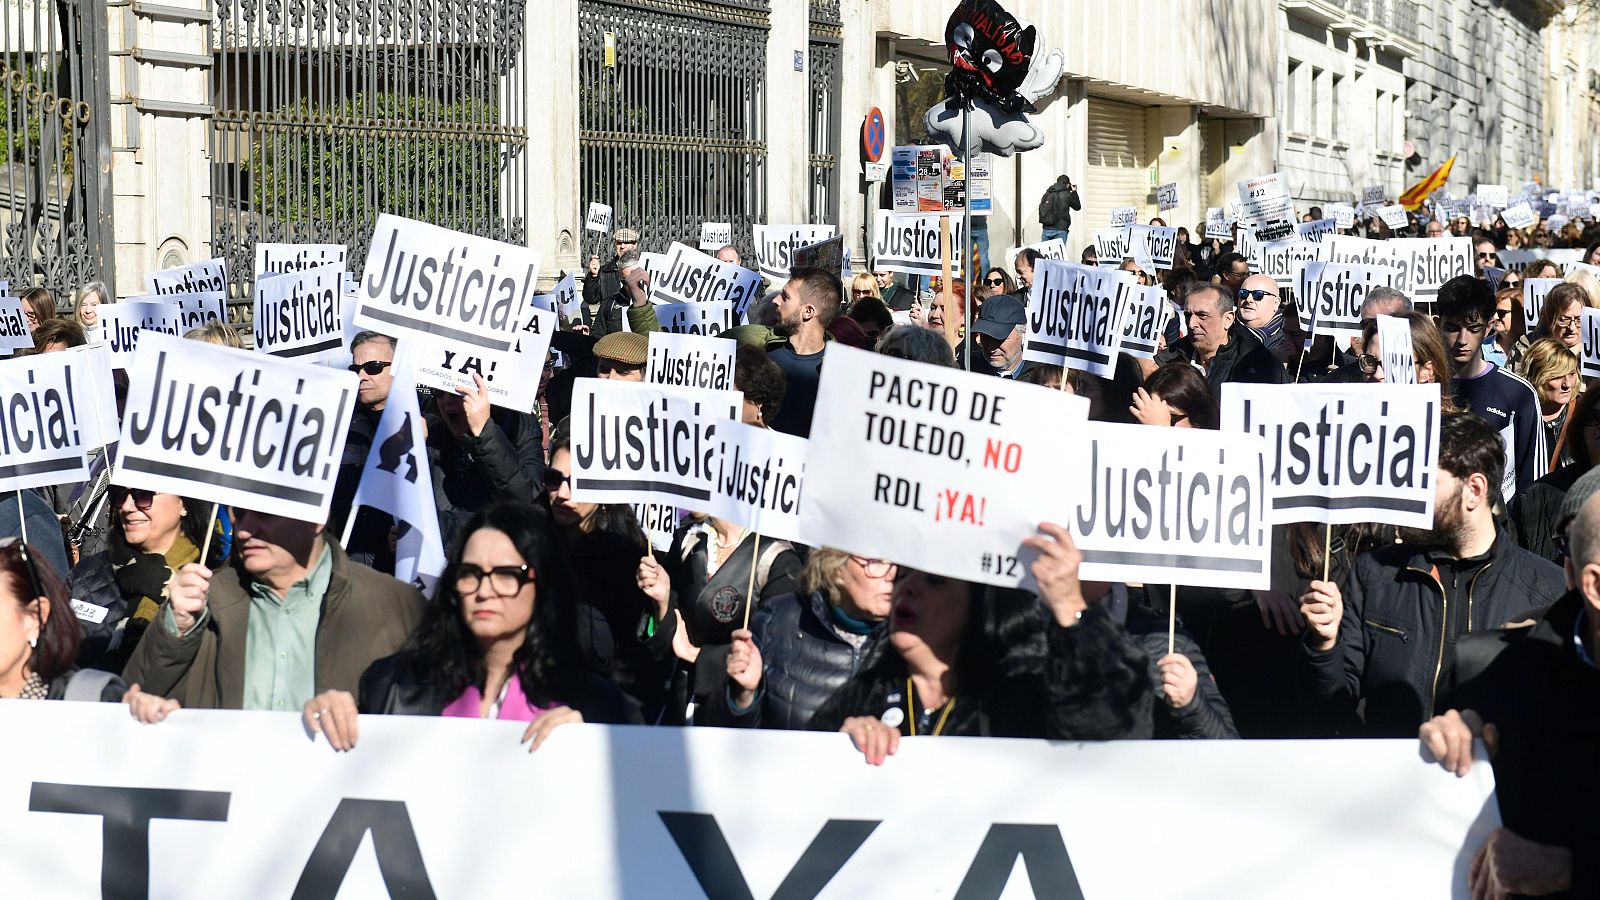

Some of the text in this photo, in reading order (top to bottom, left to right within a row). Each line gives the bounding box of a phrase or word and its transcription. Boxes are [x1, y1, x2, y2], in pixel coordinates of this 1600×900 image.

[1250, 188, 1266, 198] #J2
[877, 216, 960, 260] Justici!
[367, 228, 535, 333] Justicia!
[1031, 270, 1124, 346] Justicia!
[256, 272, 342, 349] Justicia!
[441, 350, 497, 382] YA!
[457, 377, 509, 397] PROCDORES
[130, 350, 349, 482] Justicia!
[869, 371, 1006, 426] PACTO DE
[1486, 406, 1507, 418] adidas
[576, 392, 737, 482] Justici
[865, 411, 1023, 473] TOLEDO, NO
[875, 473, 987, 527] RDL ¡YA!
[1076, 439, 1265, 547] Justicia!
[980, 550, 1018, 578] #J2
